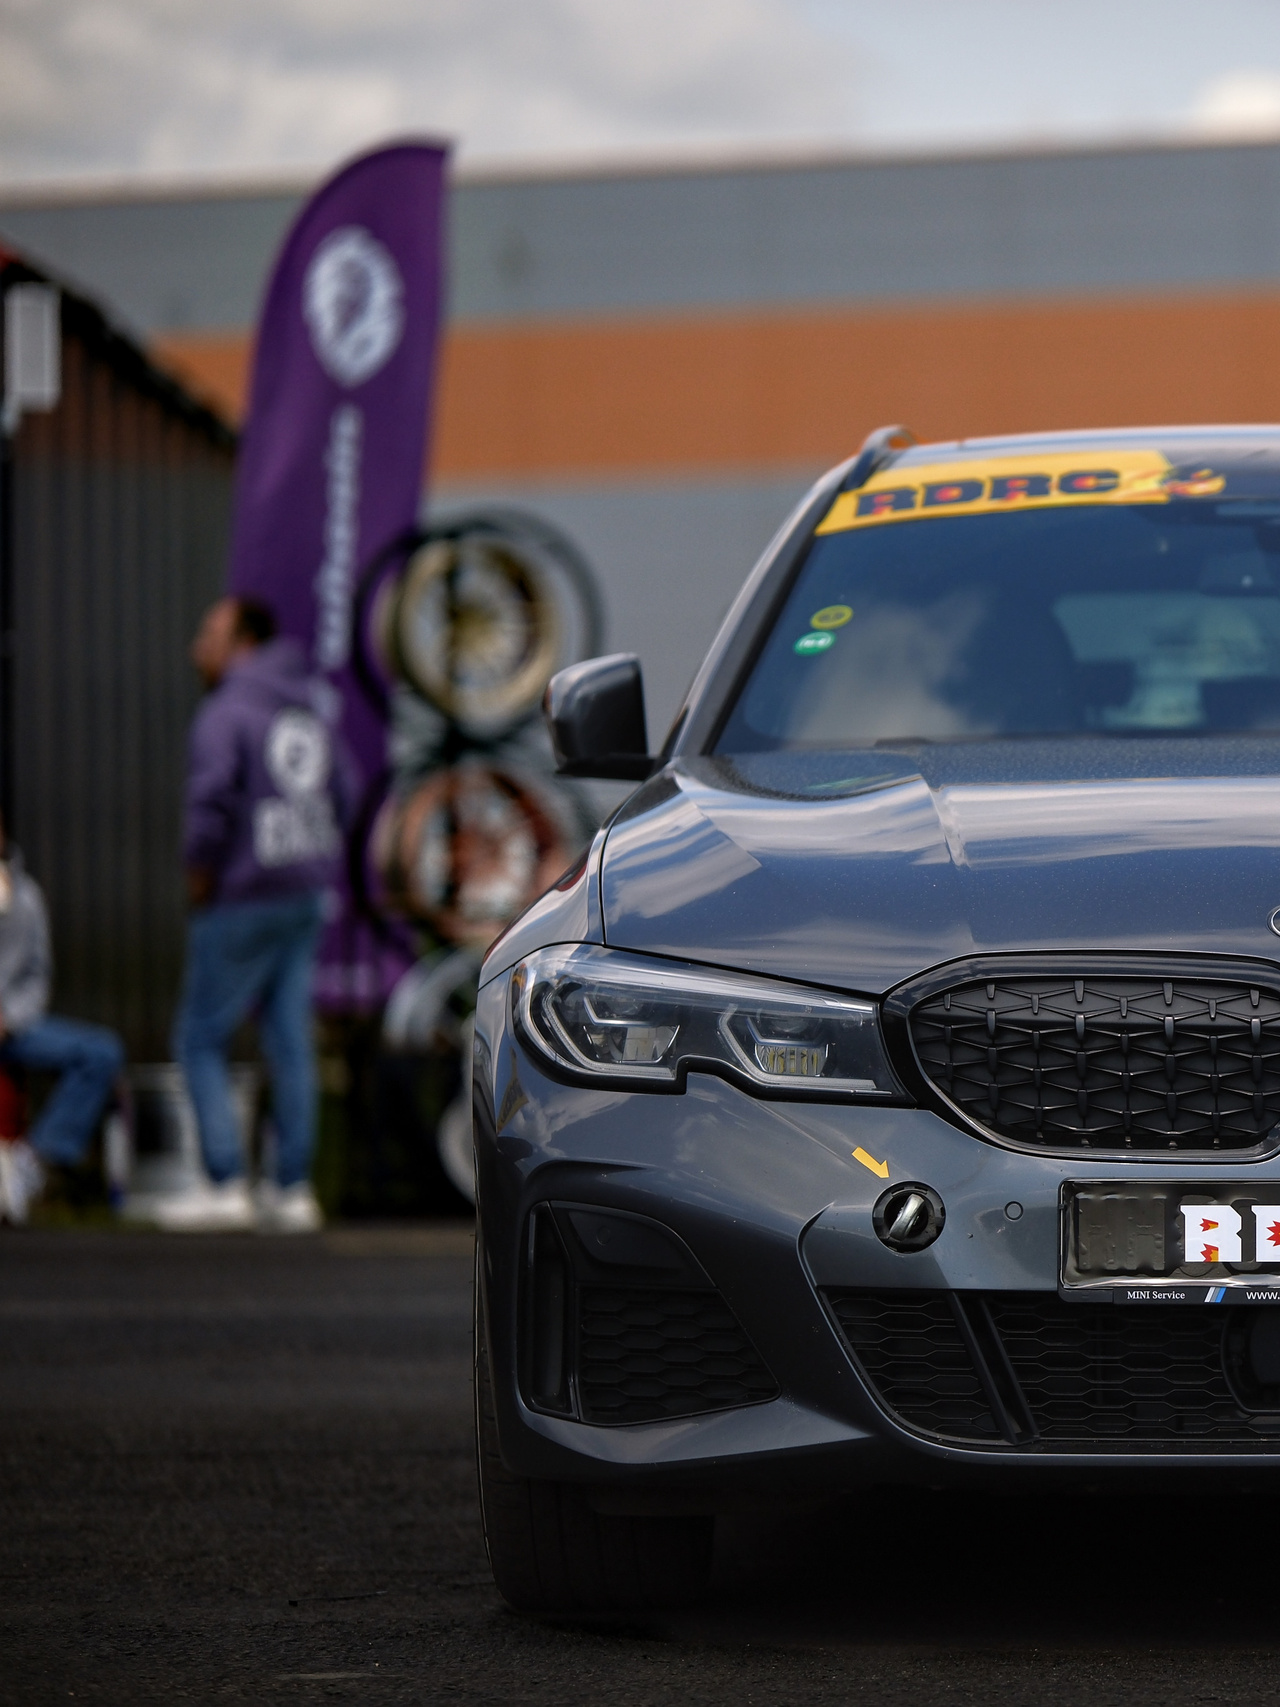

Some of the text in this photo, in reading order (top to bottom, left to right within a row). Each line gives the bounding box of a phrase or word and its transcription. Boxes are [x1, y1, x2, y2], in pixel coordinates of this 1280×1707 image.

[854, 468, 1121, 519] RDRC
[1127, 1290, 1186, 1300] MINI Service
